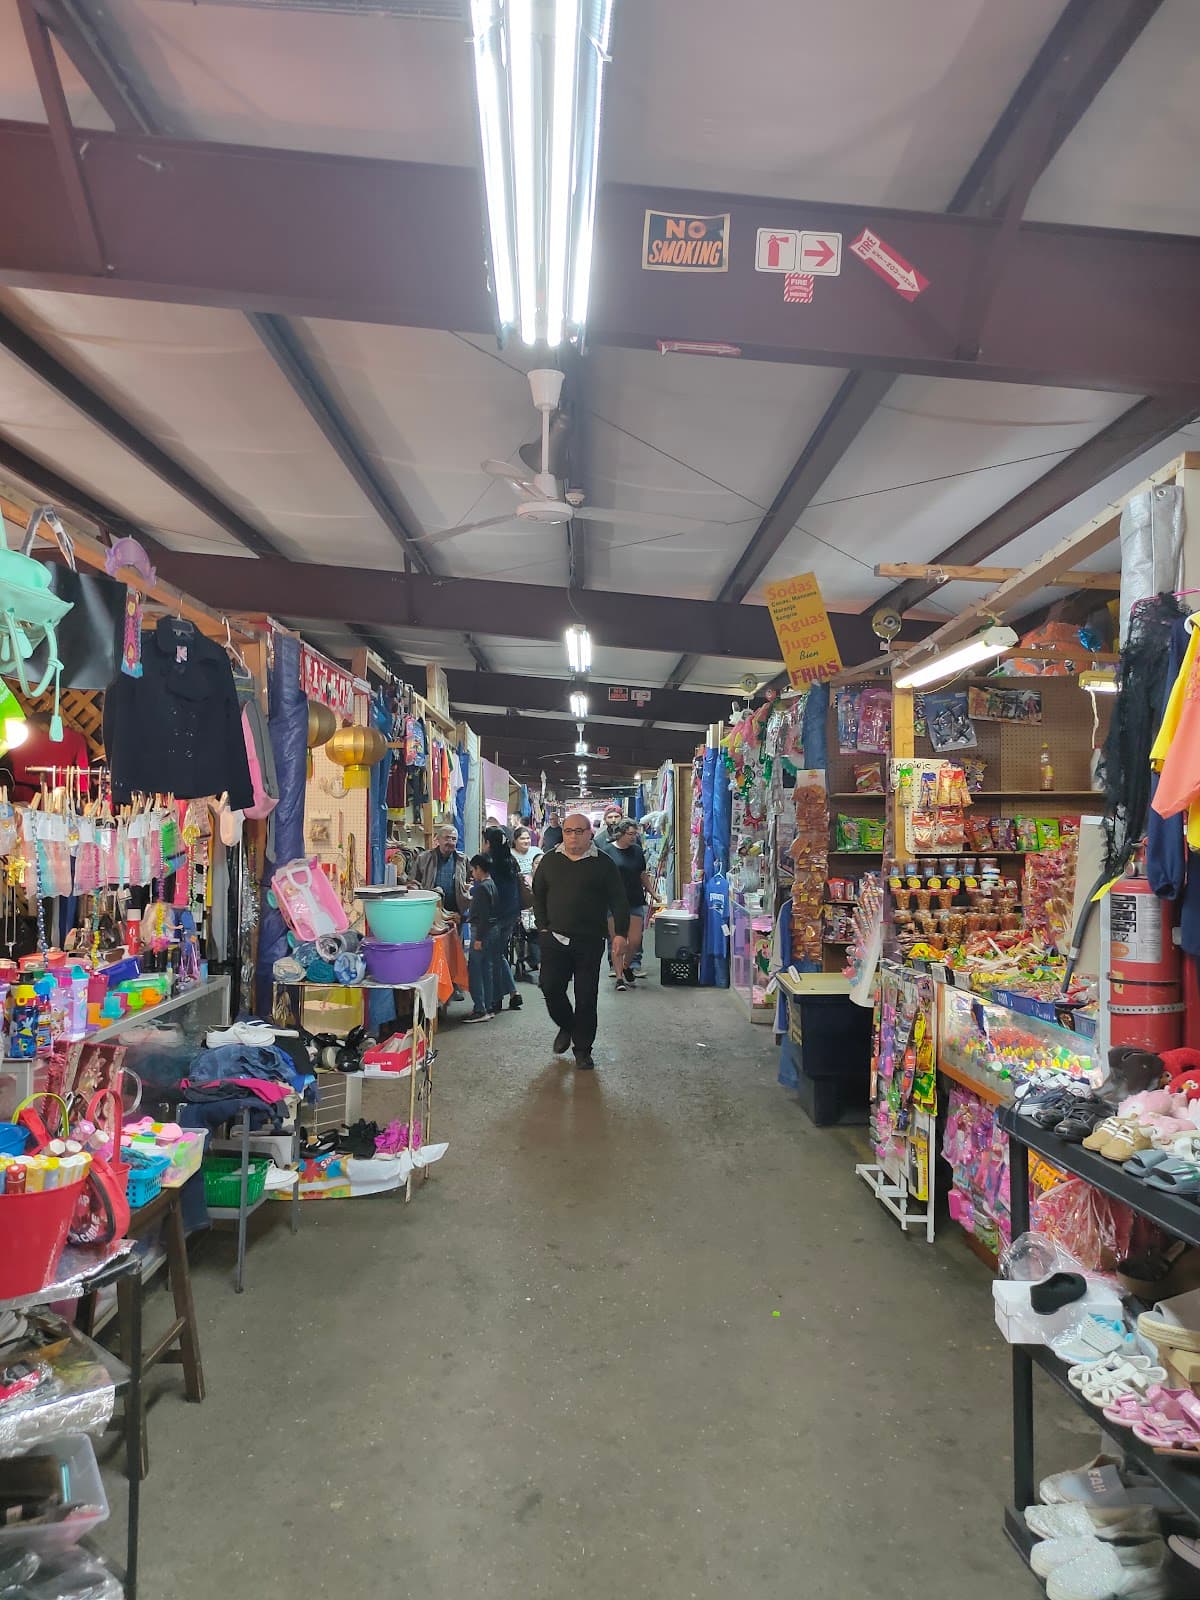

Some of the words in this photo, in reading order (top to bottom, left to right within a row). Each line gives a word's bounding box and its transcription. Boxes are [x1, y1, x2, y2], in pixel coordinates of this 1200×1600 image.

[666, 218, 706, 239] NO
[649, 240, 722, 265] SMOKING
[858, 236, 877, 256] FIRE
[767, 579, 813, 600] Sodas
[779, 612, 825, 635] Aguas
[783, 631, 827, 656] Jugos
[791, 659, 841, 687] FRIAS
